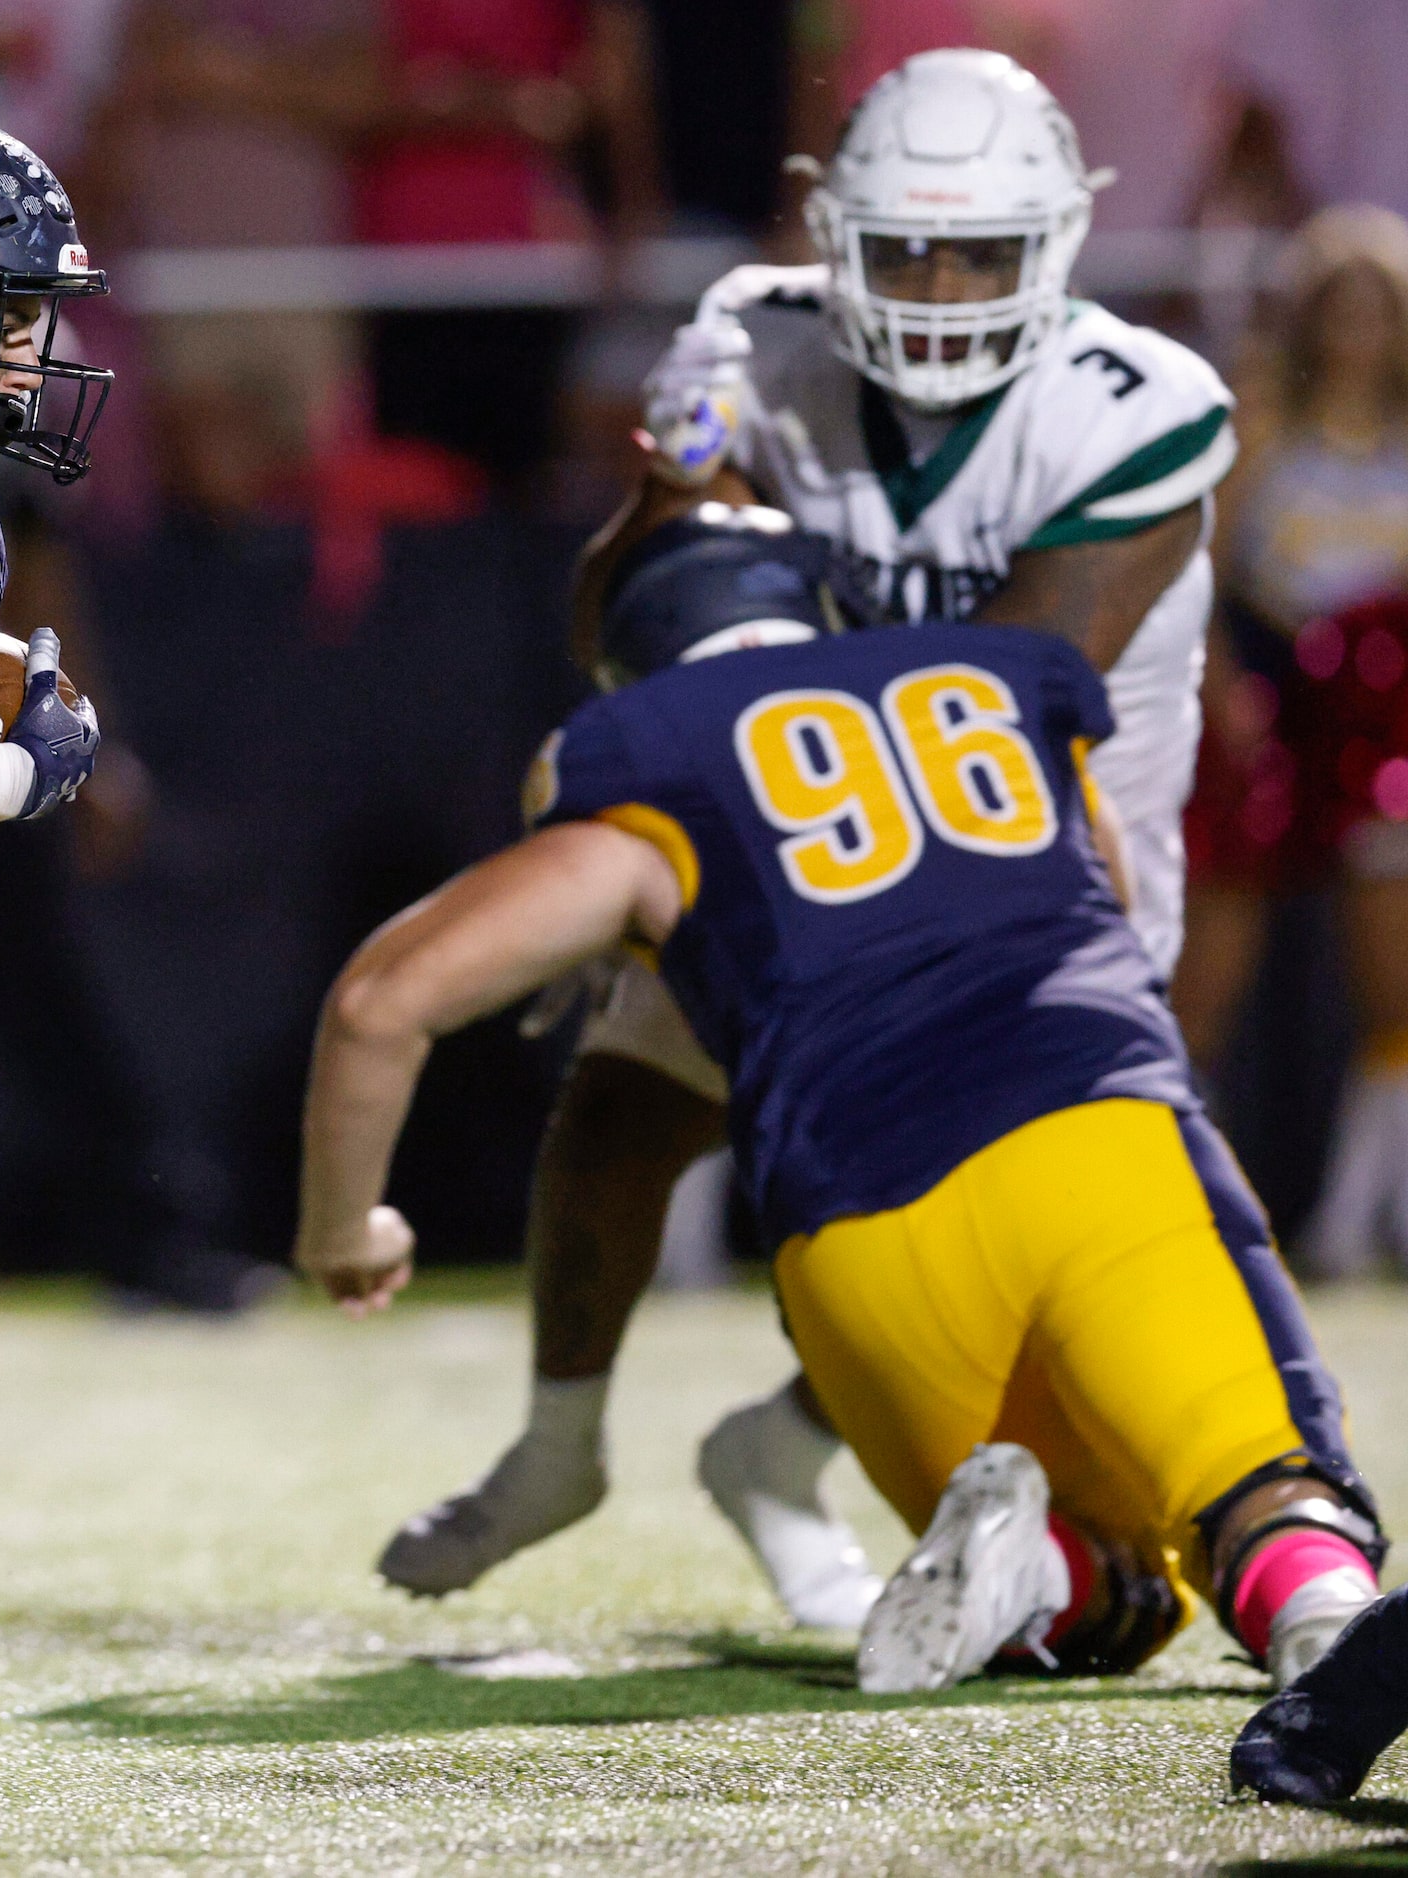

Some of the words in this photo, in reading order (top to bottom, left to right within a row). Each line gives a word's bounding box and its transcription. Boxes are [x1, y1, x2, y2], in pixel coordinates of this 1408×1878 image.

[21, 194, 44, 216] PRIDE
[1071, 348, 1145, 399] 3
[734, 662, 1059, 905] 96
